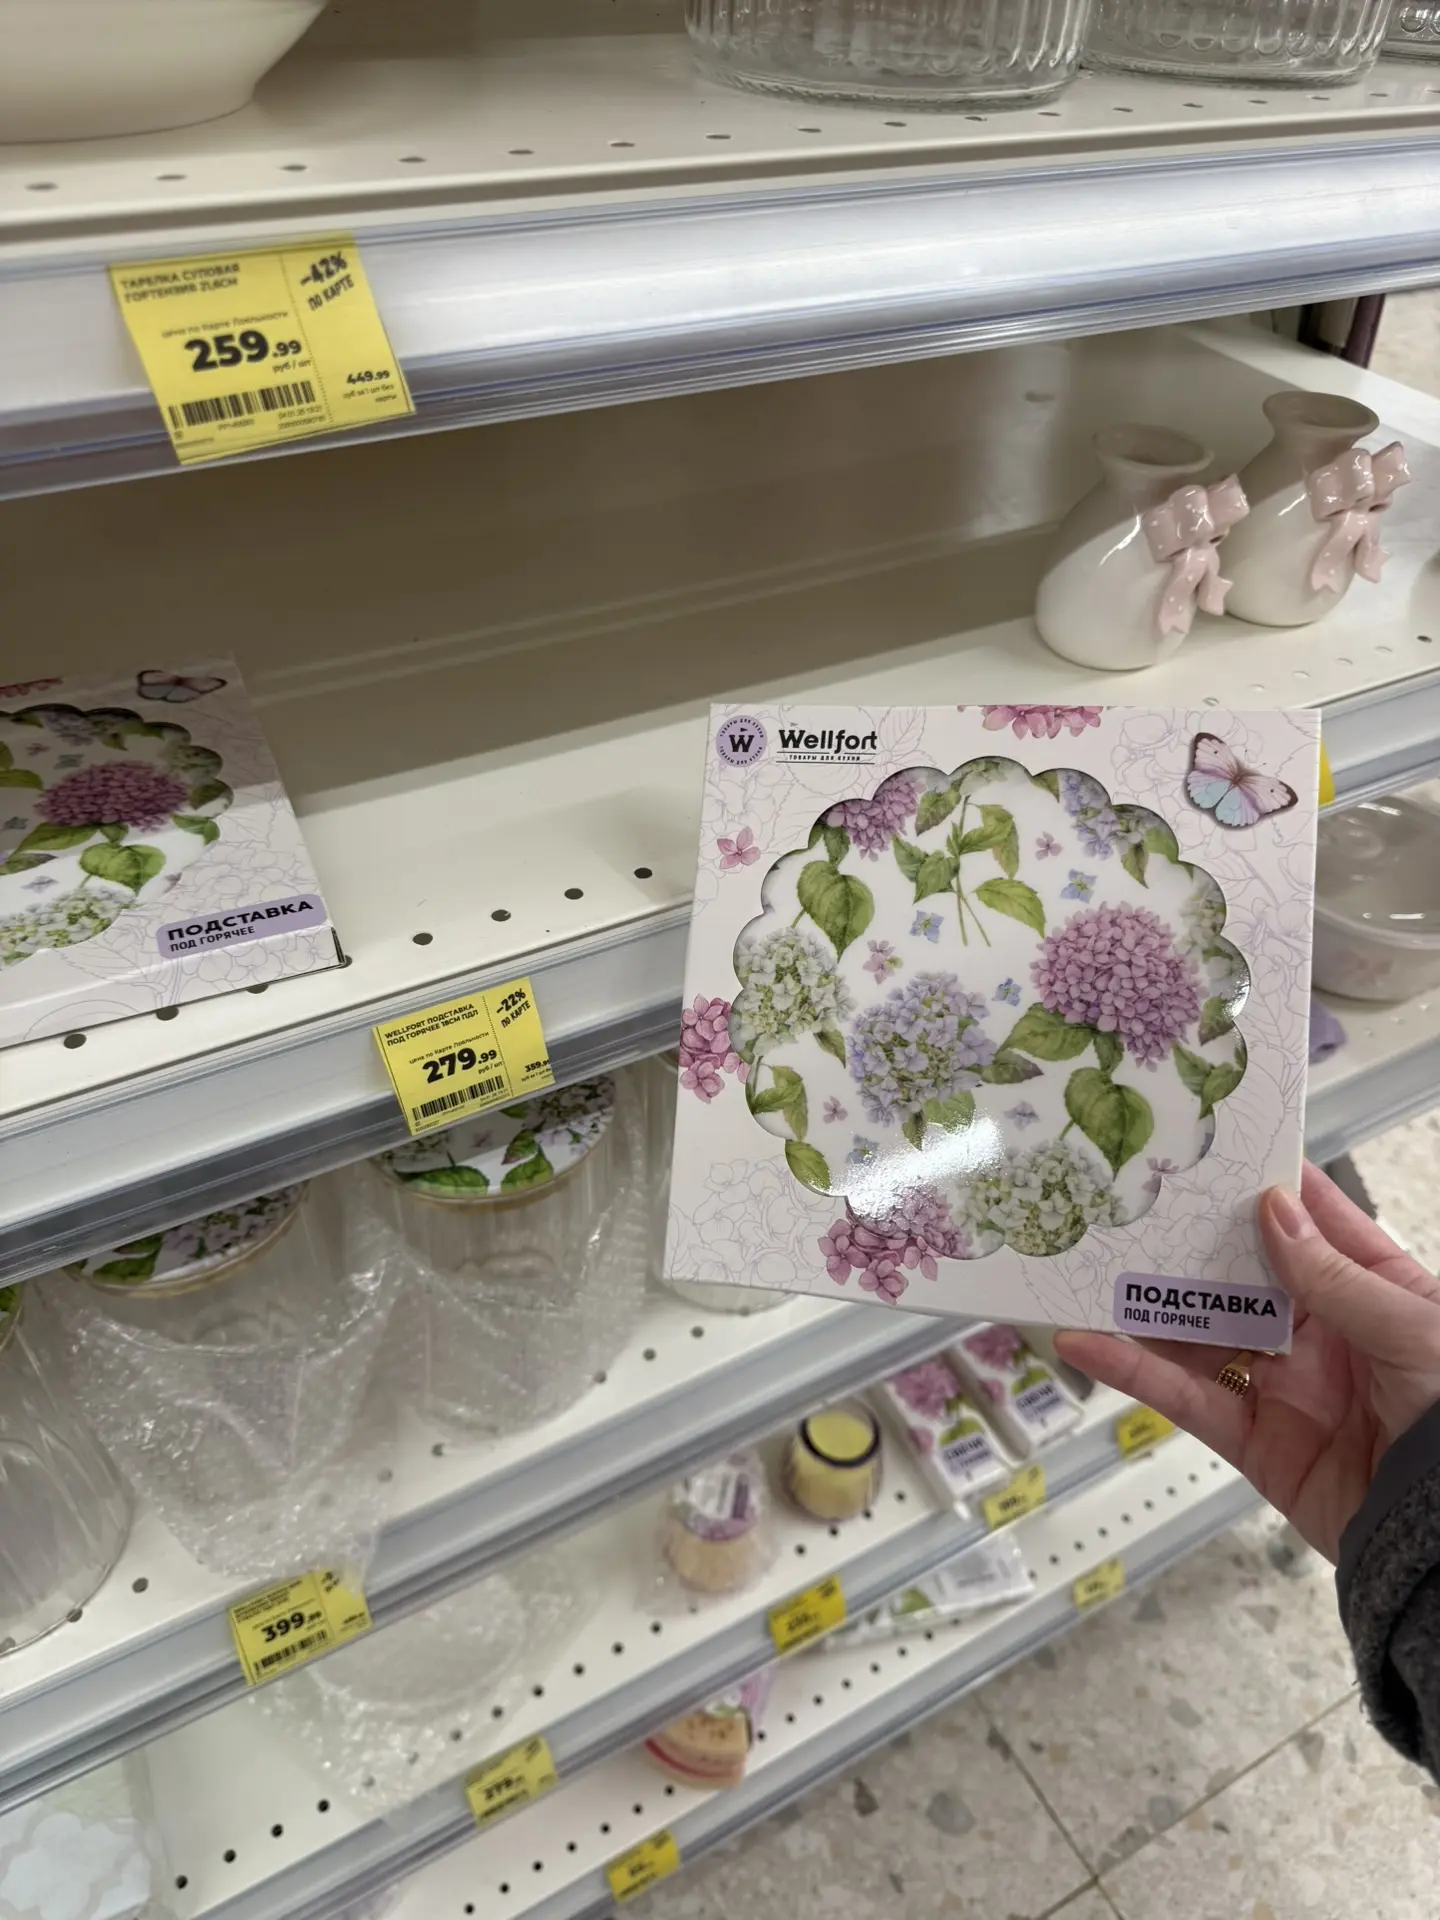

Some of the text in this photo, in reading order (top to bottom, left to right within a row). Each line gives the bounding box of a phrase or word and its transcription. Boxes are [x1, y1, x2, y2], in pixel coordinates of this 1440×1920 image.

[300, 250, 348, 286] -42%
[307, 273, 355, 311] ПО КАРТЕ
[272, 362, 292, 374] руб
[346, 369, 391, 385] 449.99
[728, 734, 755, 753] W
[778, 729, 878, 754] Wellfort
[168, 900, 314, 941] ПОДСТАВКА
[170, 925, 256, 952] ПОД ГОРЯЧЕЕ
[496, 987, 527, 1014] -22%
[385, 1003, 474, 1040] WELLFORT ПОДСТАВКА
[501, 1000, 531, 1029] ПО КАРТЕ
[387, 1036, 406, 1047] ПОД
[405, 1023, 441, 1040] ГОРЯЧЕЕ
[409, 1055, 425, 1065] цена
[425, 1051, 434, 1059] по
[453, 1031, 490, 1048] Лояльности
[1125, 1283, 1278, 1318] ПОДСТАВКА
[1124, 1307, 1212, 1330] ПОД ГОРЯЧЕЕ
